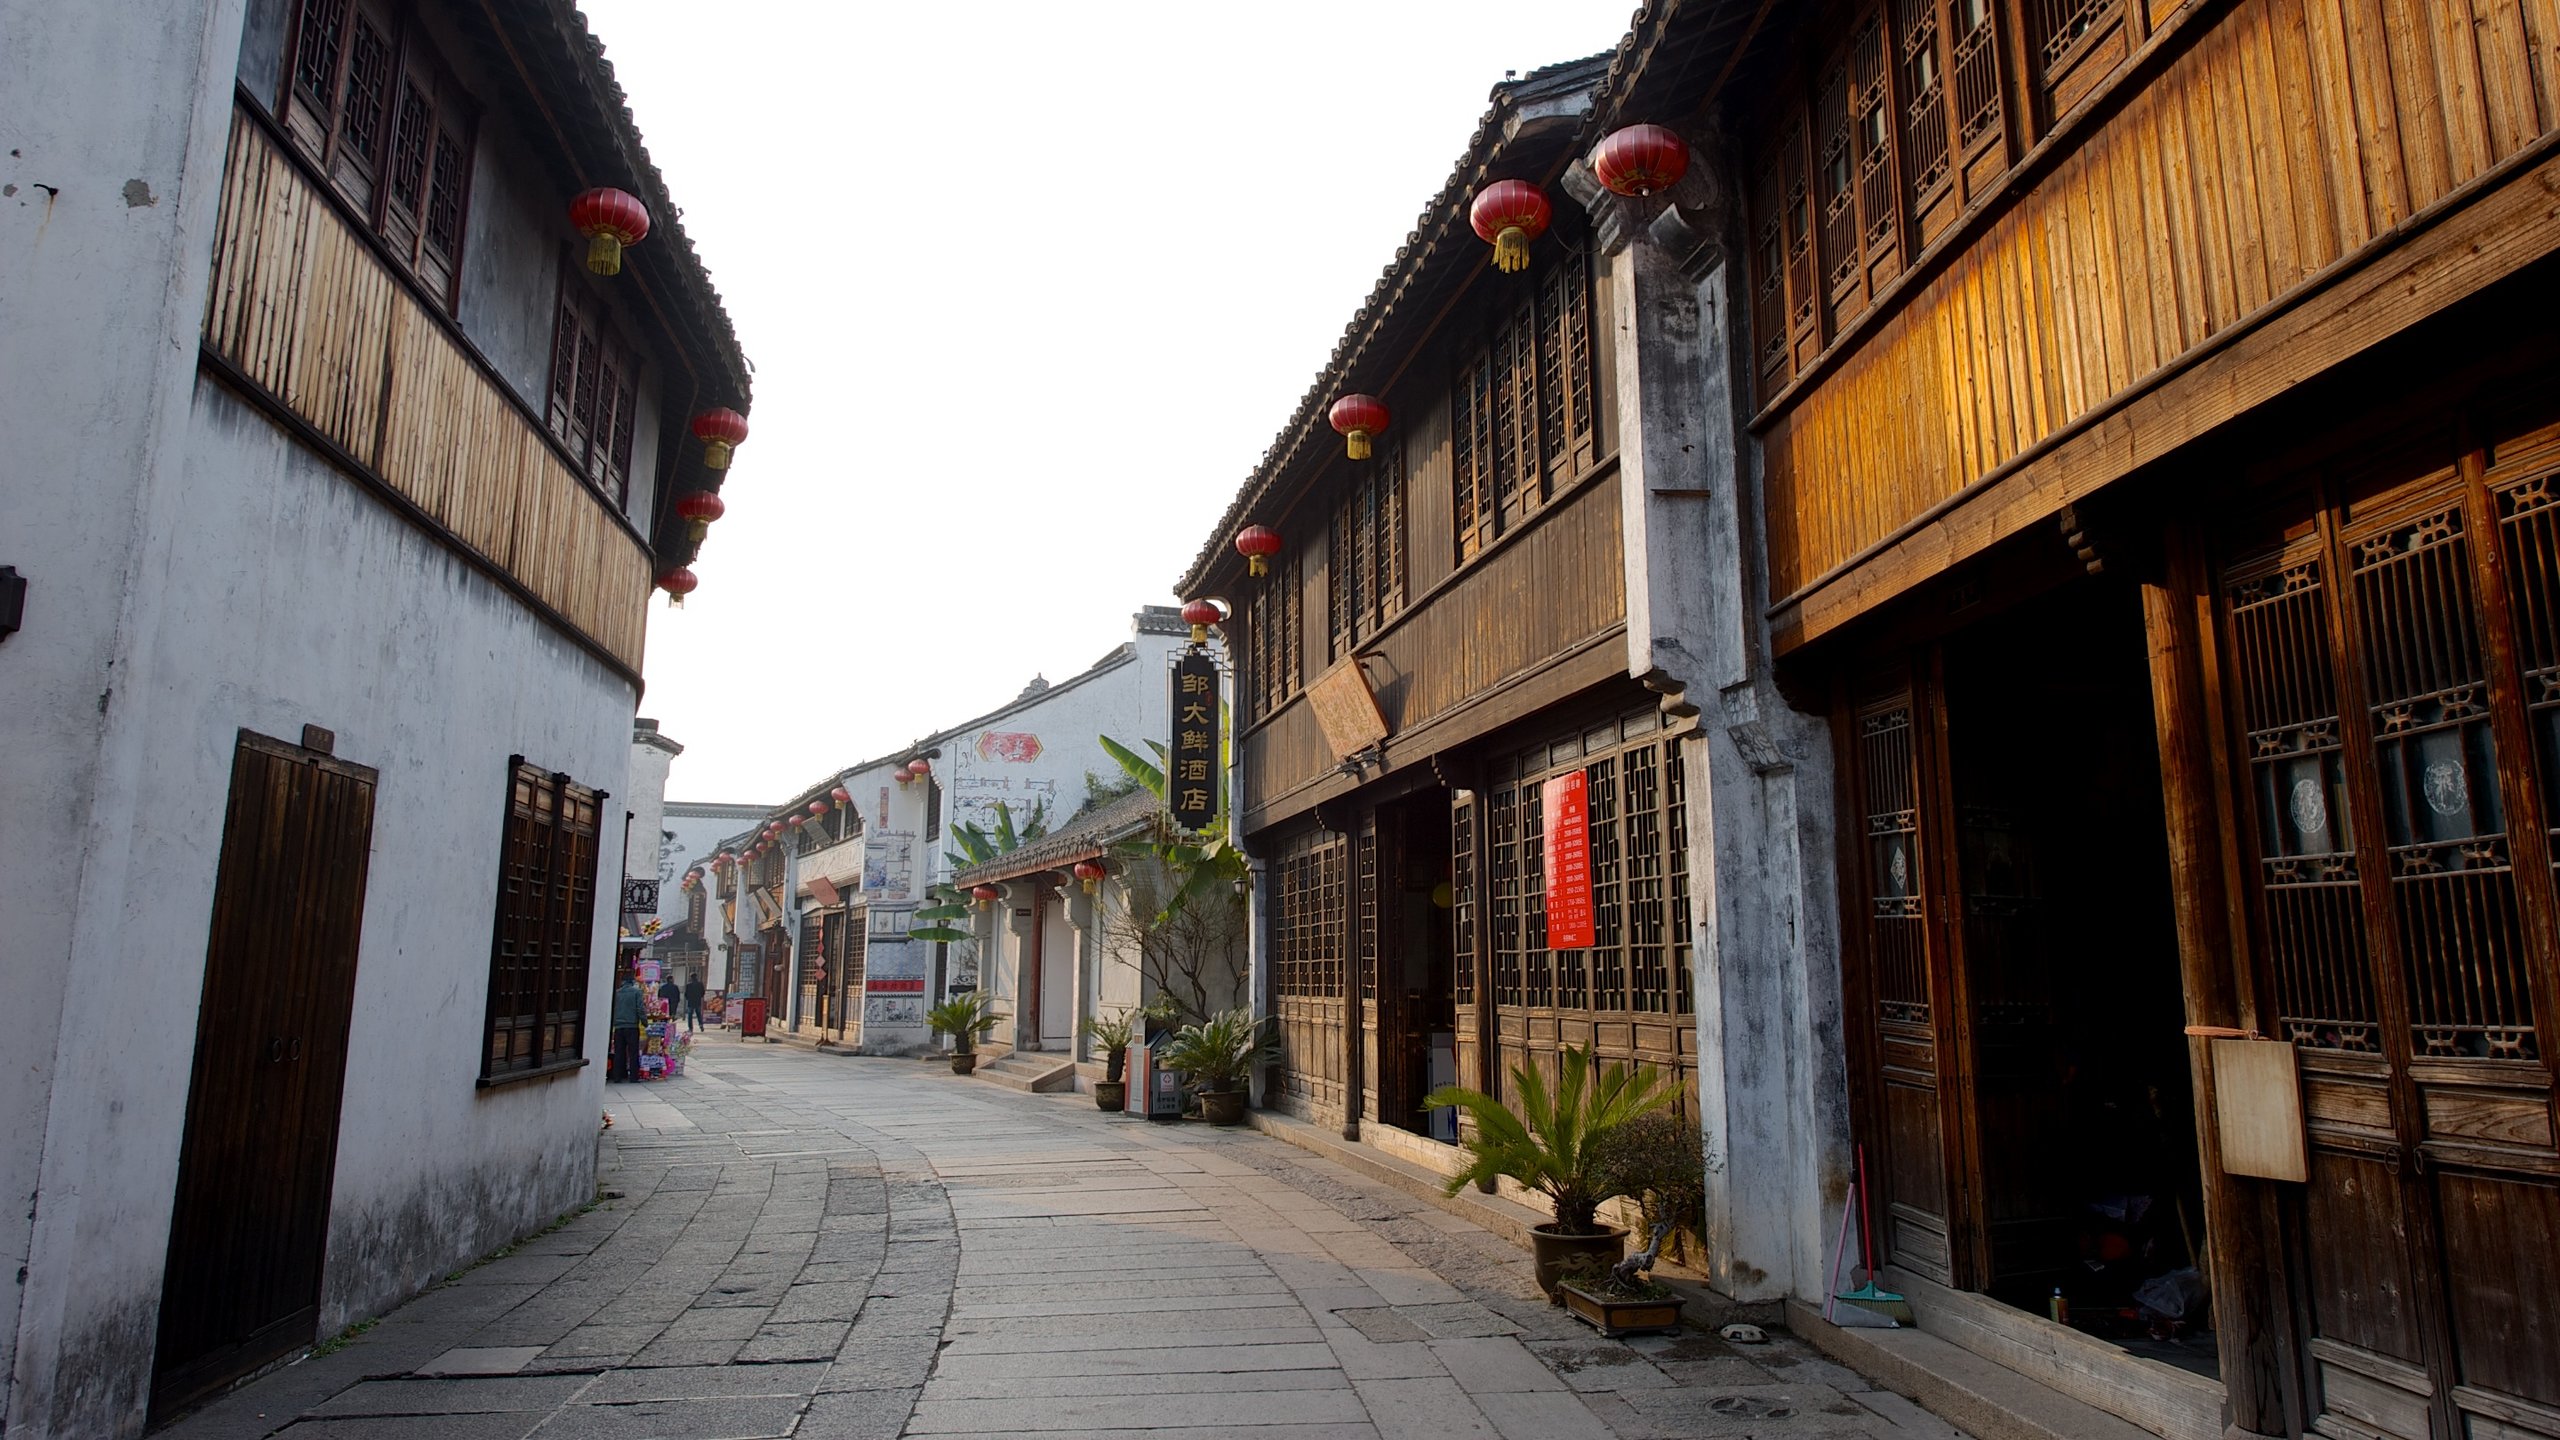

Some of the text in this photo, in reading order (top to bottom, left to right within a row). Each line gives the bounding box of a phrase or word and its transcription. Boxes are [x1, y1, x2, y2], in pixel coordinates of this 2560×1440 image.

[1181, 674, 1209, 811] 邹大鲜酒店
